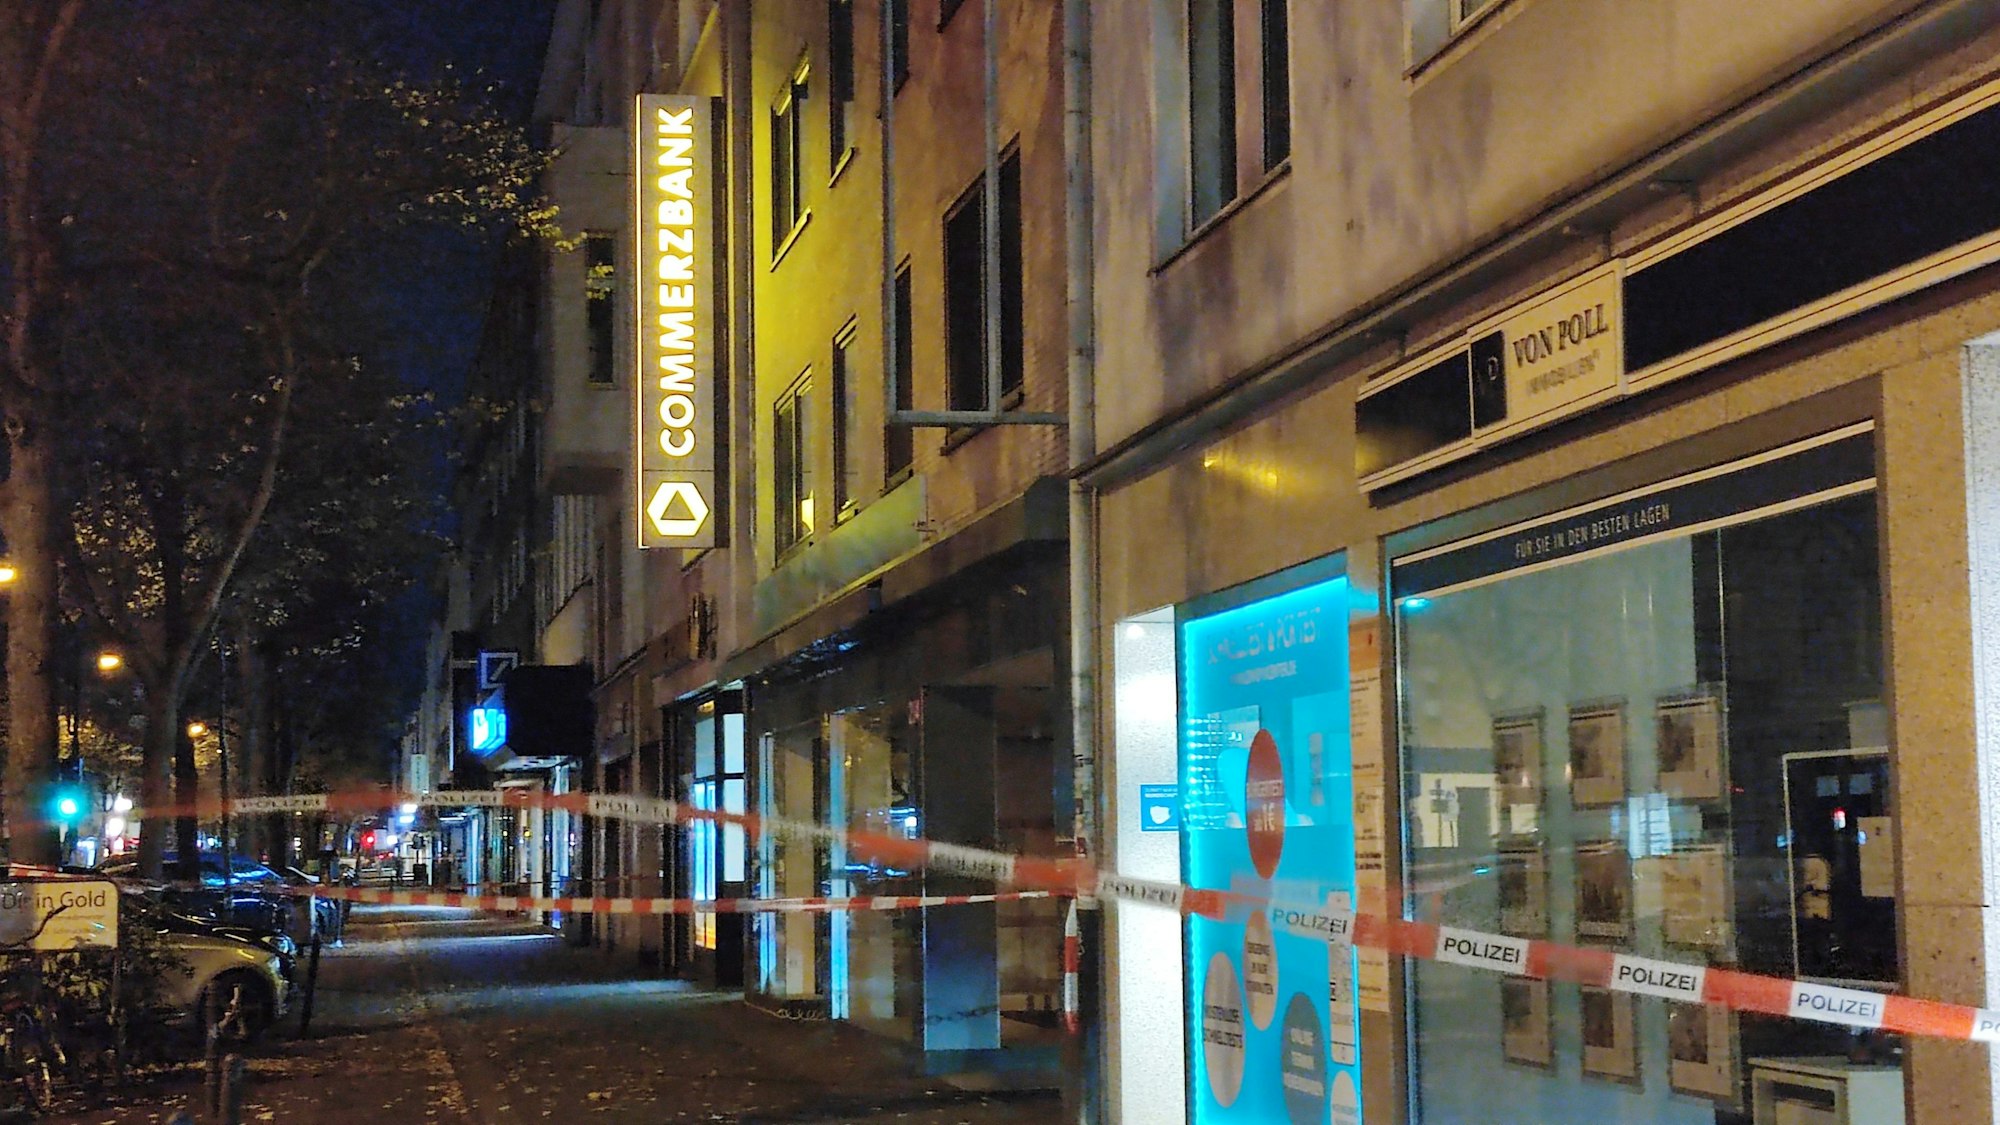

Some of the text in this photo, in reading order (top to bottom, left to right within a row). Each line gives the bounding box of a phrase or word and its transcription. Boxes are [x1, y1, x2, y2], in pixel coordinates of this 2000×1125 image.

[658, 106, 696, 457] COMMERZBANK
[1512, 303, 1610, 369] VON POLL
[1536, 535, 1550, 554] SIE
[1567, 526, 1589, 546] DEN
[1591, 515, 1630, 540] BESTEN
[1634, 503, 1670, 529] LAGEN
[36, 893, 55, 909] in
[60, 890, 106, 909] Gold
[1273, 908, 1348, 934] POLIZEI
[1443, 937, 1521, 964] POLIZEI
[1618, 965, 1697, 992] POLIZEI
[1797, 992, 1878, 1018] POLIZEI
